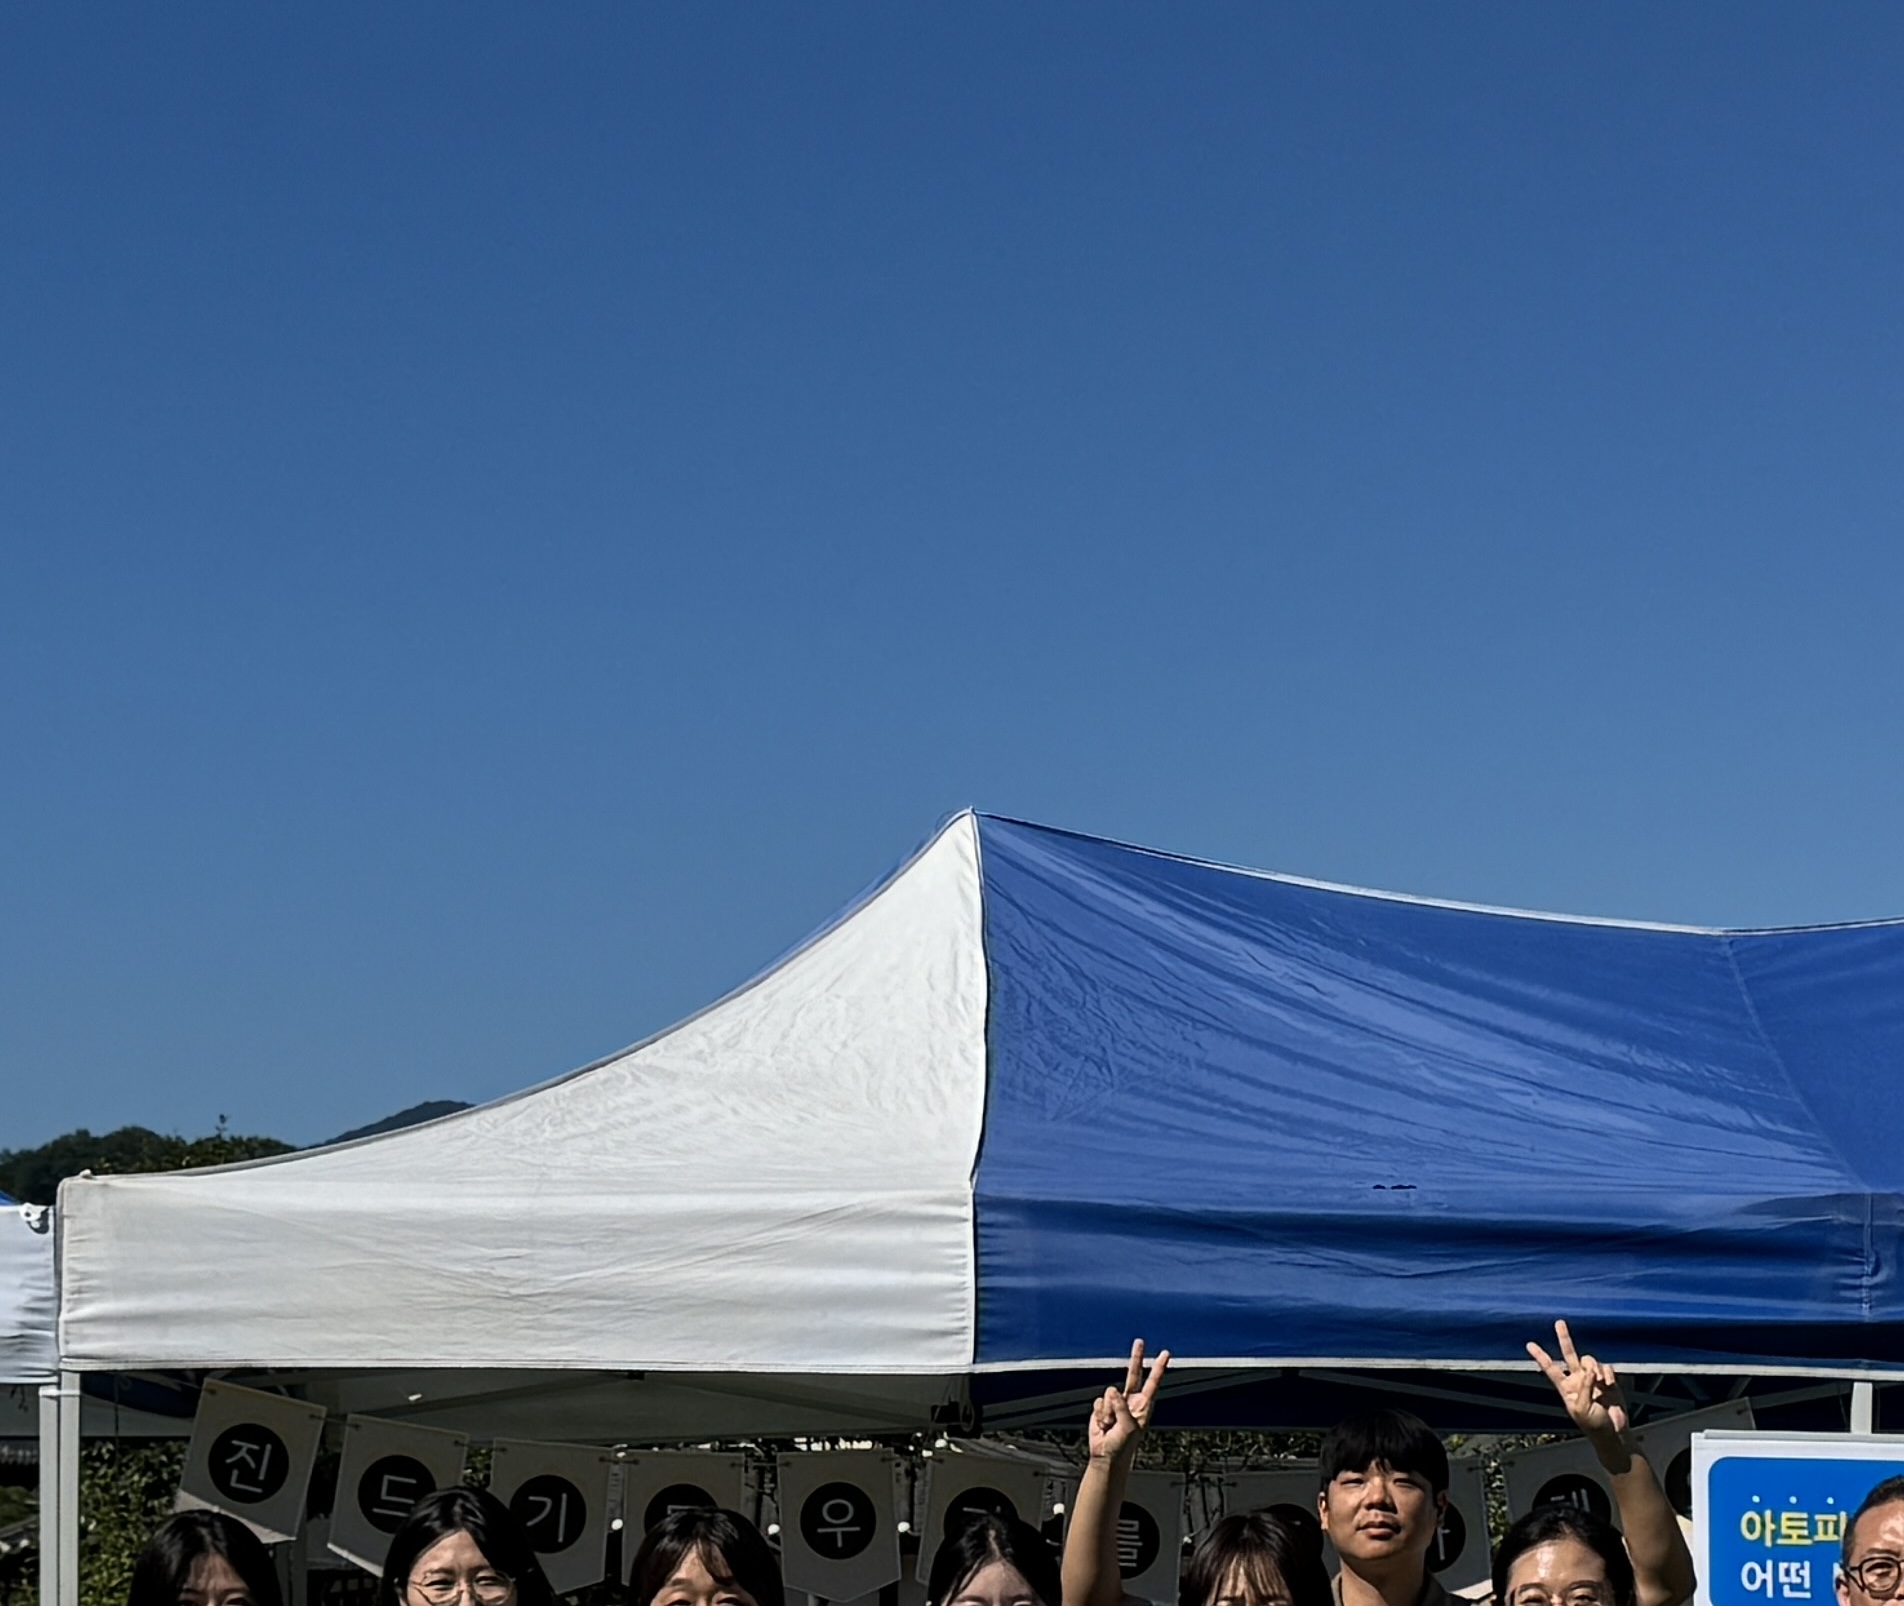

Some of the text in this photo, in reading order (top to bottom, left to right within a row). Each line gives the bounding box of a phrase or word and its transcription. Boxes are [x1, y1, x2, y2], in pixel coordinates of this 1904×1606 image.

[223, 1440, 269, 1495] 진
[528, 1494, 570, 1544] 기
[816, 1499, 862, 1551] 우
[1740, 1560, 1813, 1600] 어떤
